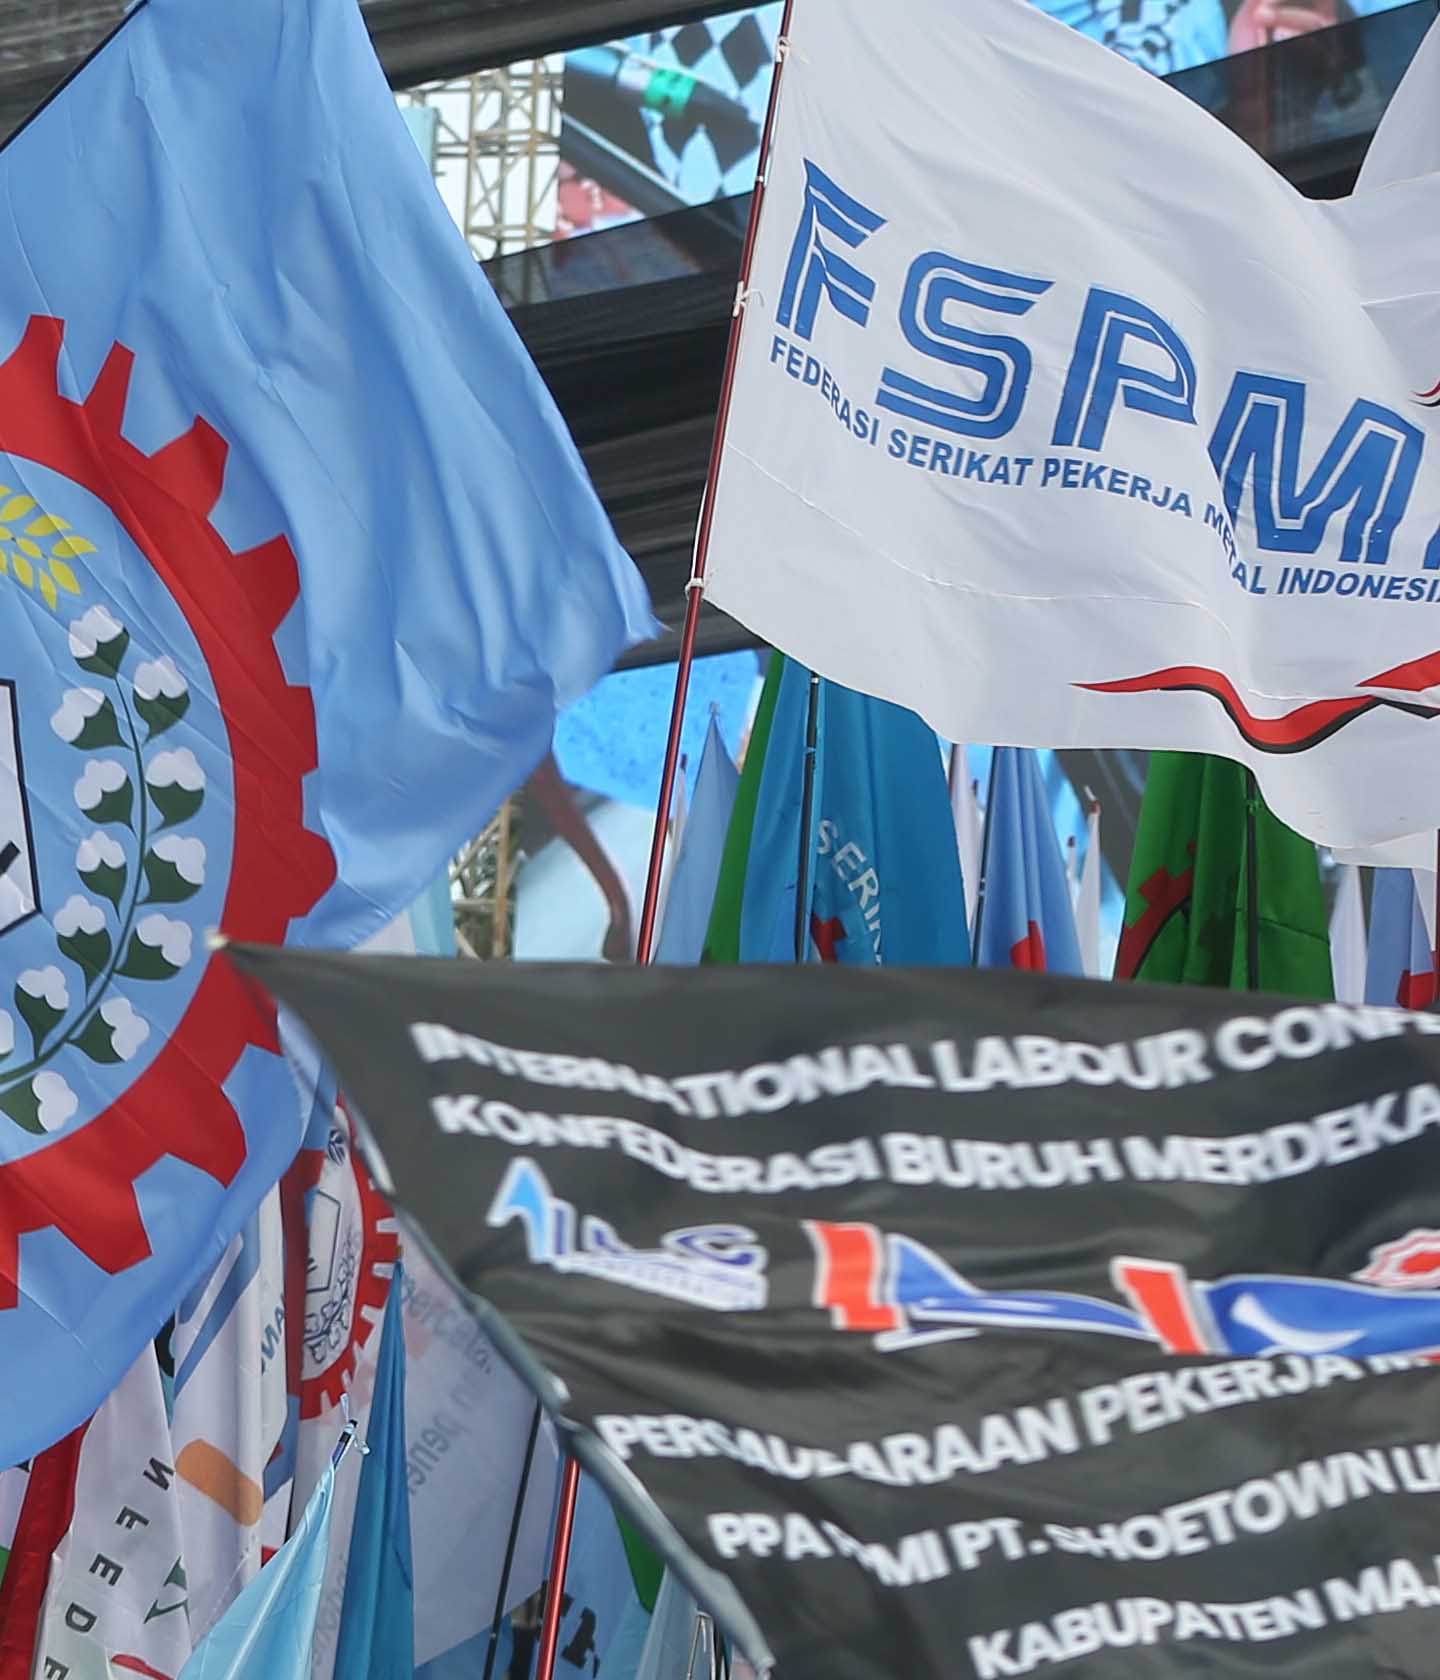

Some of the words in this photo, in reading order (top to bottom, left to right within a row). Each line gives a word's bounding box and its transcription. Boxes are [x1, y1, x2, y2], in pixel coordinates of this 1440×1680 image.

[769, 335, 879, 446] FEDERASI
[887, 429, 1033, 489] SERIKAT
[1041, 459, 1191, 519] PEKERJA
[1203, 502, 1265, 596] METAL
[410, 1021, 932, 1119] INTERNATIONAL
[933, 1029, 1212, 1093] LABOUR
[431, 1095, 879, 1194] KONFEDERASI
[886, 1132, 1118, 1188] BURUH
[1080, 1353, 1361, 1446] PEKERJA
[950, 1517, 1048, 1571] PT.
